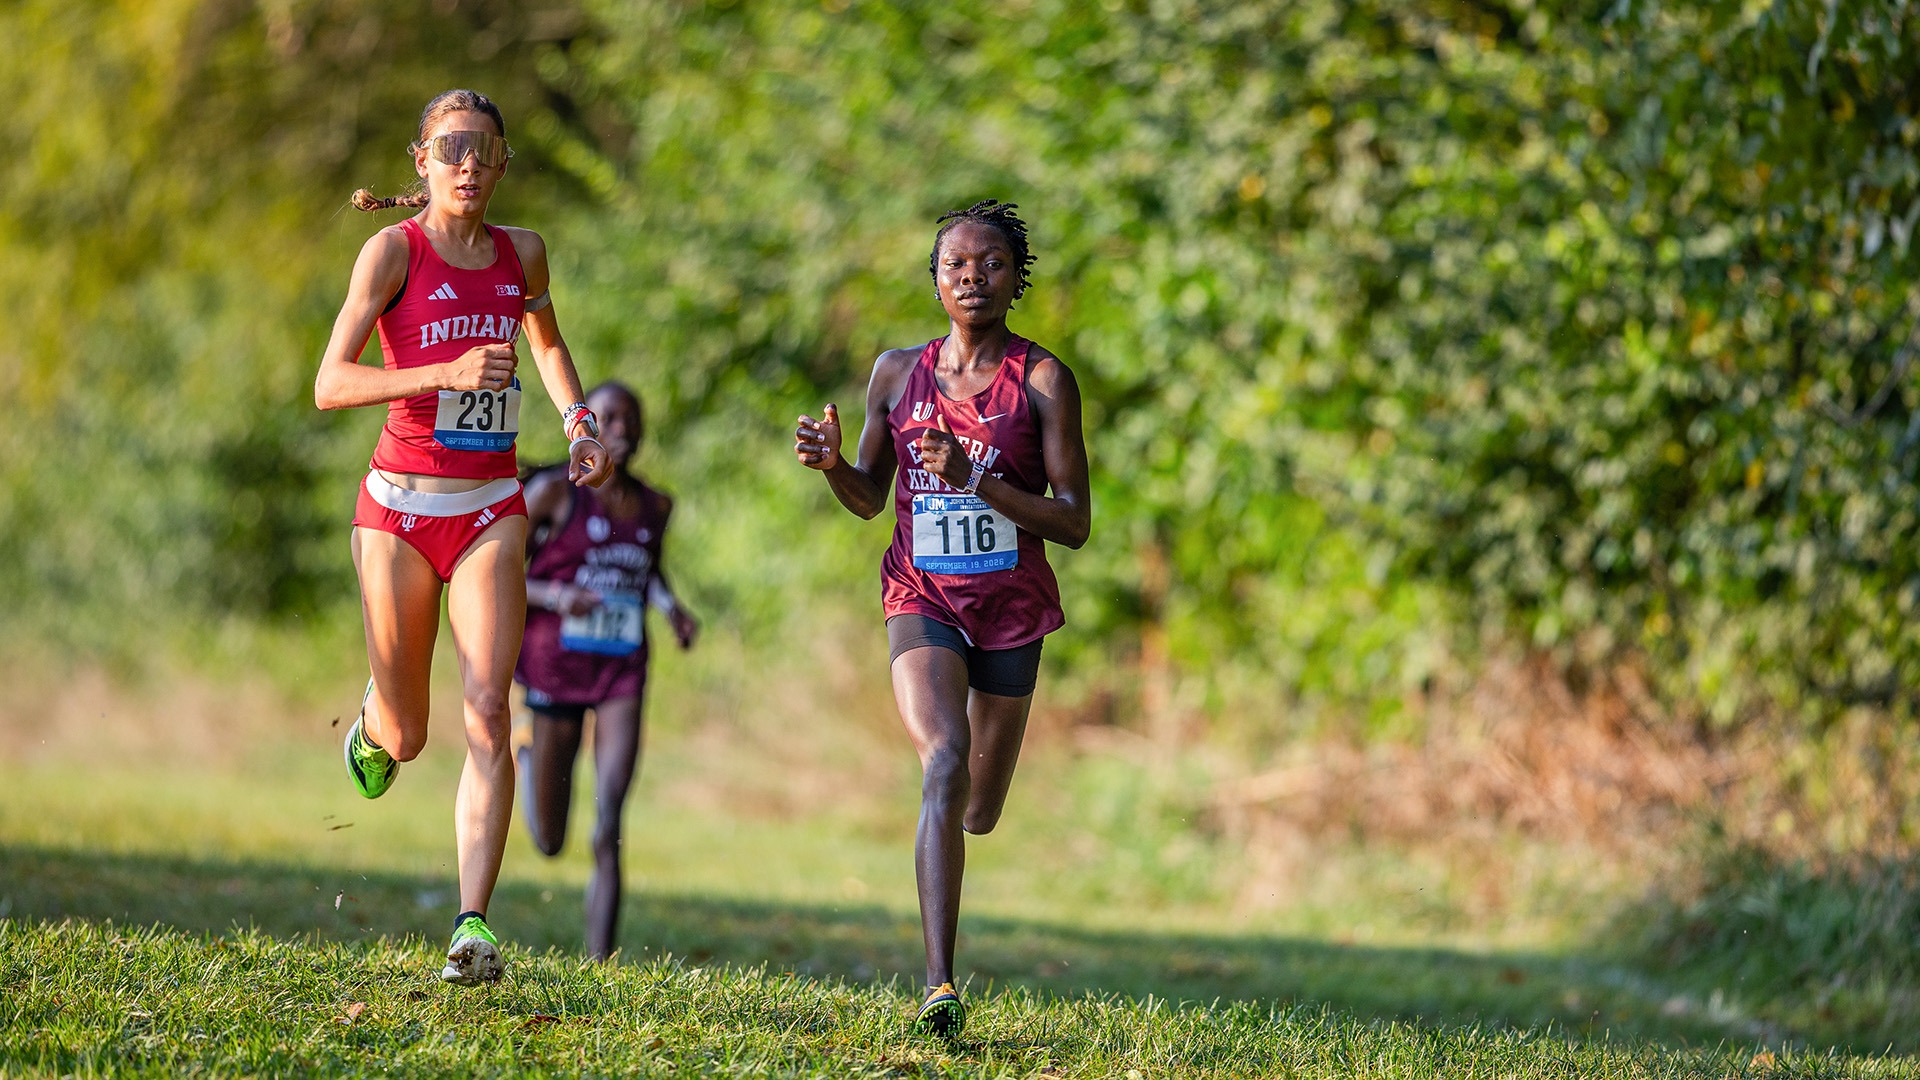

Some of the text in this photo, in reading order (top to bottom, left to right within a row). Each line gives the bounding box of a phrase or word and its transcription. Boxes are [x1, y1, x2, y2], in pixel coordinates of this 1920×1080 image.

[456, 391, 507, 431] 231
[445, 437, 484, 446] SEPTEMBER
[907, 435, 1001, 469] EERN
[929, 498, 945, 510] JM
[936, 514, 995, 554] 116
[926, 562, 967, 570] SEPTEMBER
